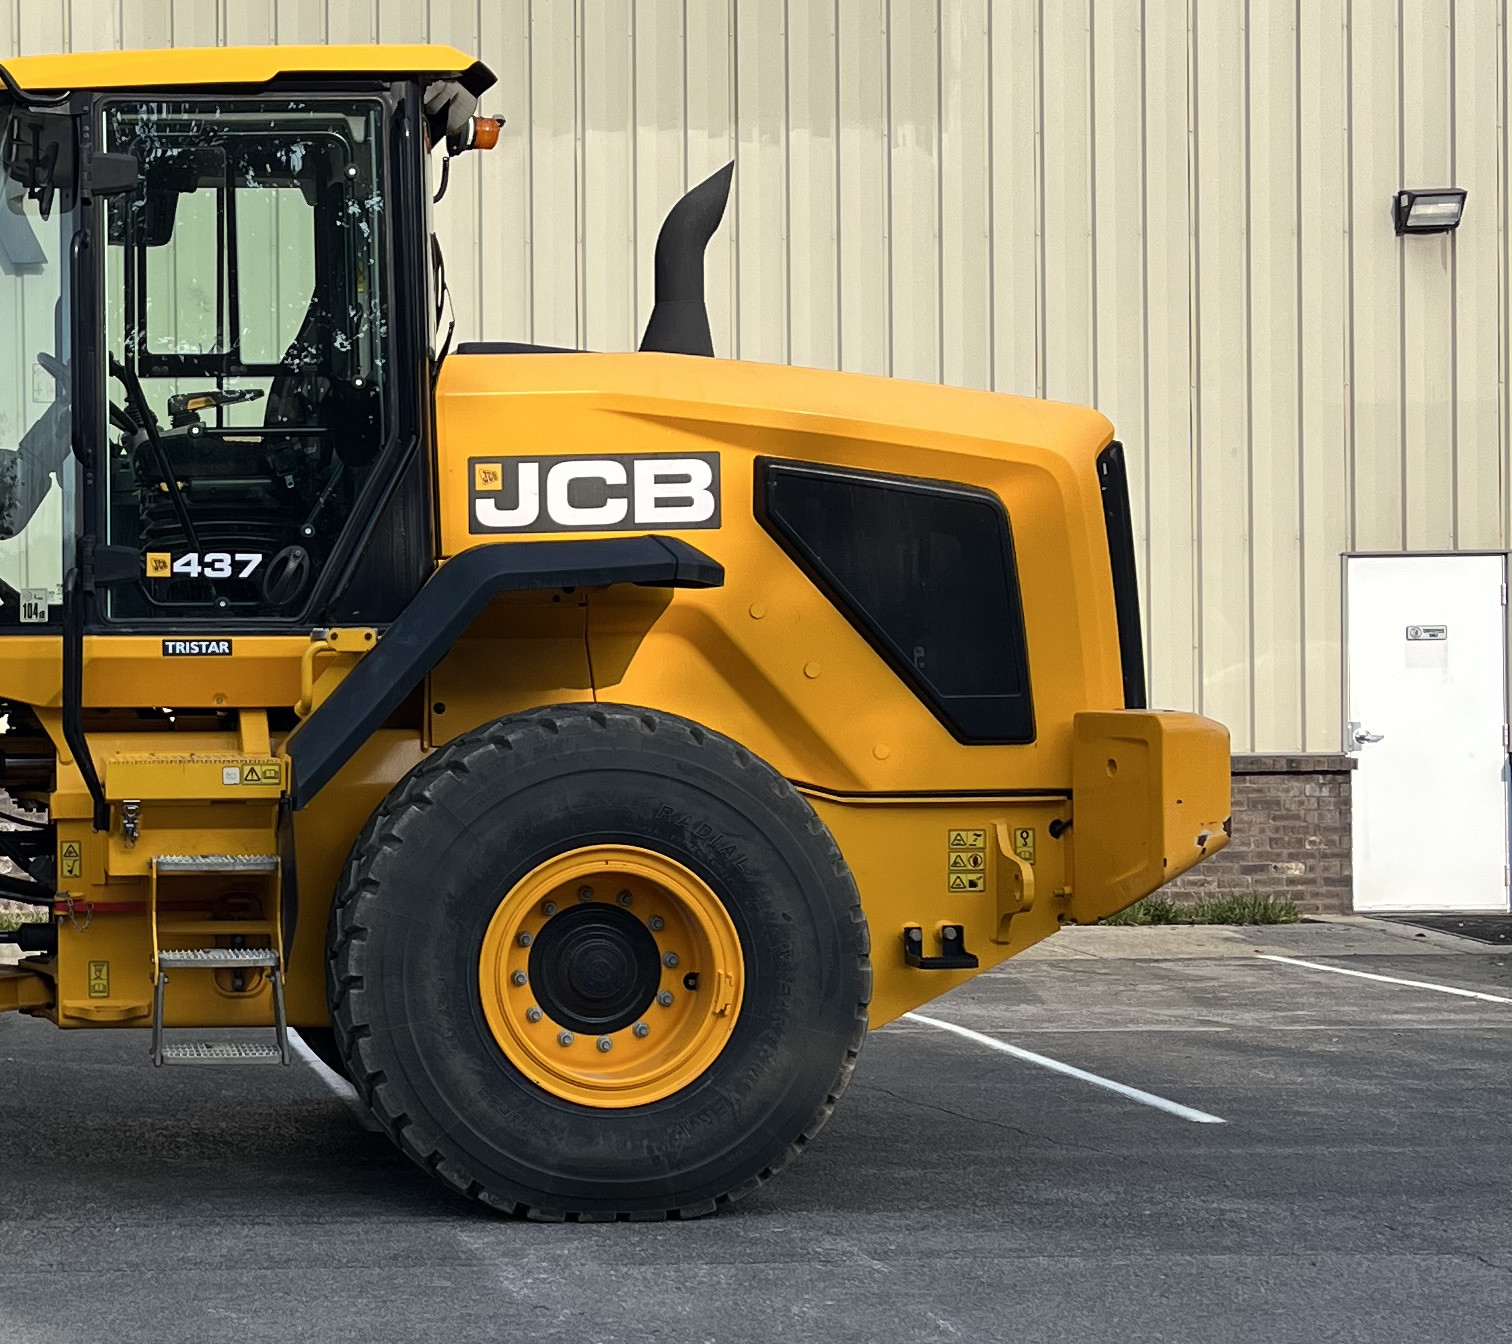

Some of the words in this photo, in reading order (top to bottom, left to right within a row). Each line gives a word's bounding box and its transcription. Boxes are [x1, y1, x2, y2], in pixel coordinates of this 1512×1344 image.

[475, 458, 715, 527] JCB
[173, 552, 262, 578] 437
[23, 602, 38, 619] 104
[164, 641, 230, 654] TRISTAR
[657, 804, 748, 872] RADIAL
